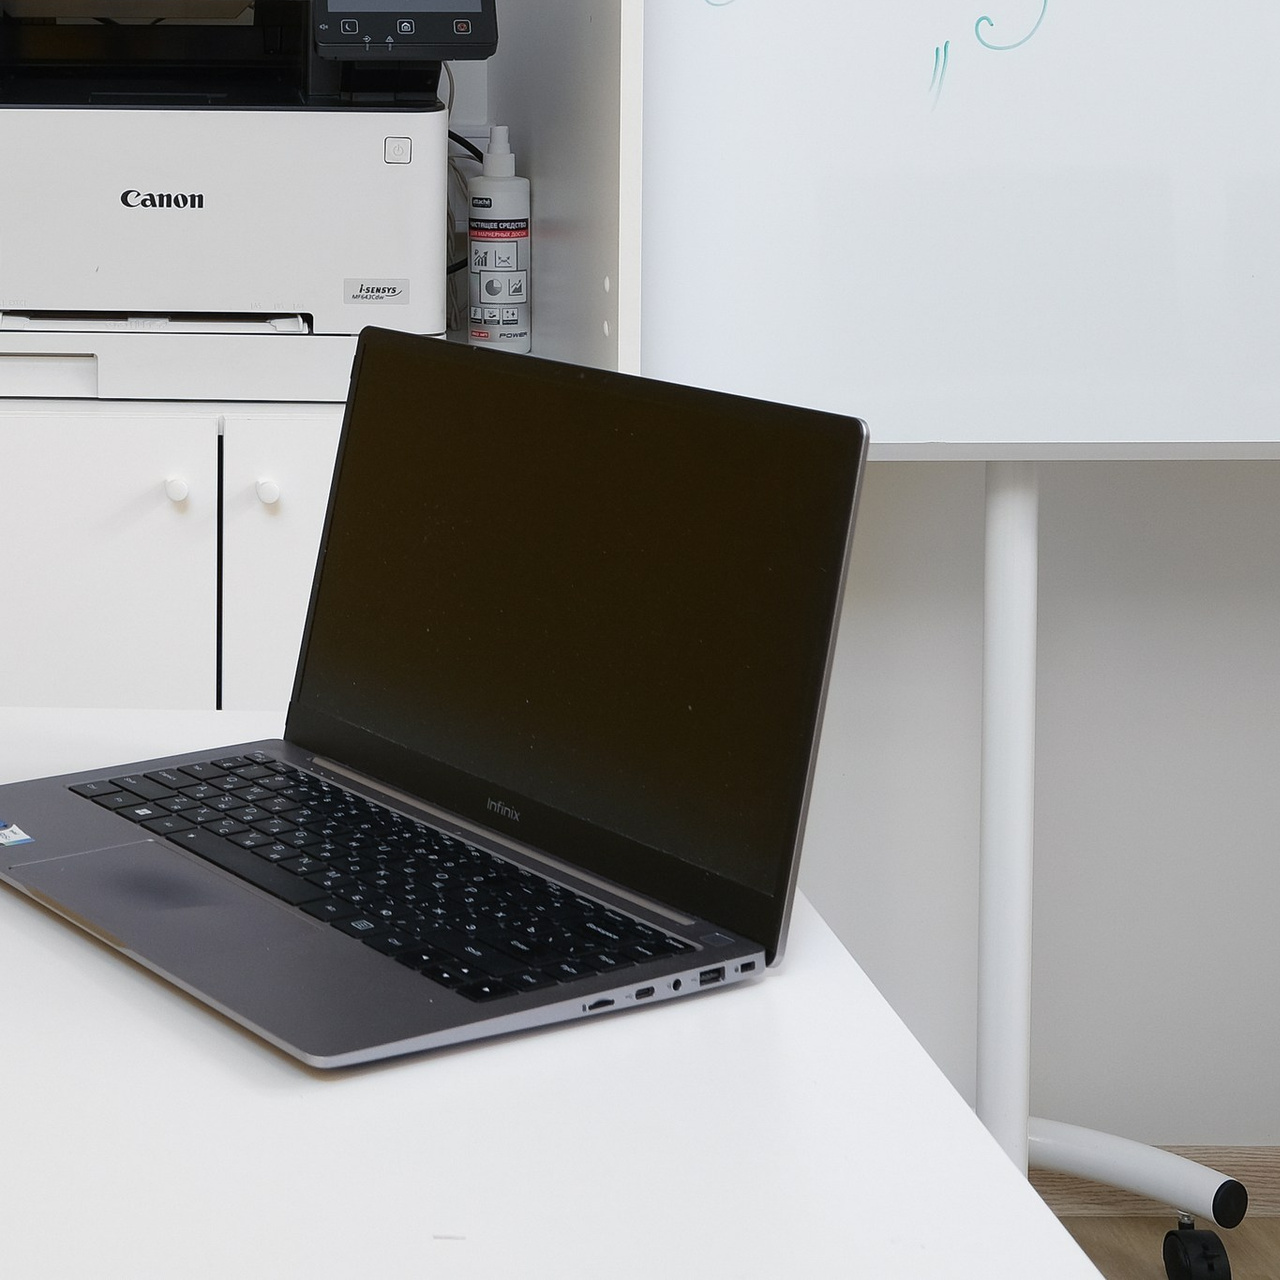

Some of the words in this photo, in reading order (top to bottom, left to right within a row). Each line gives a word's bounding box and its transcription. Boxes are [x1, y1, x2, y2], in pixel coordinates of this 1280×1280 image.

[120, 189, 204, 209] Canon
[498, 221, 527, 230] СРЕДСТВО
[359, 283, 397, 294] i-SENSYS
[486, 797, 521, 822] Infinix
